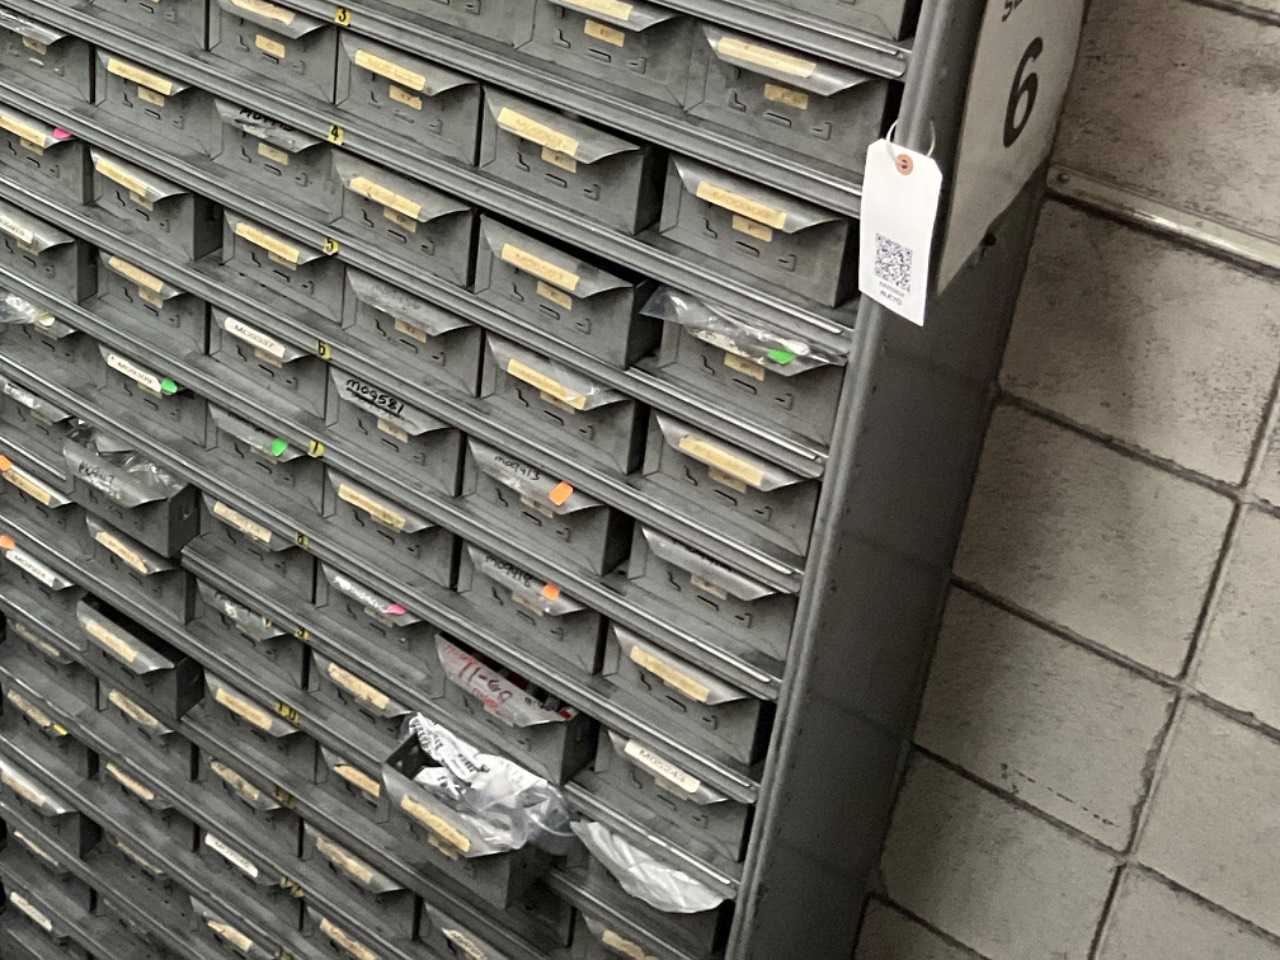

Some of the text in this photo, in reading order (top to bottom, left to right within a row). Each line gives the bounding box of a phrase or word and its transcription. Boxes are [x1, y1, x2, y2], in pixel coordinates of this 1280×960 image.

[337, 7, 347, 22] 3
[1002, 36, 1044, 149] 6
[330, 124, 339, 141] 4
